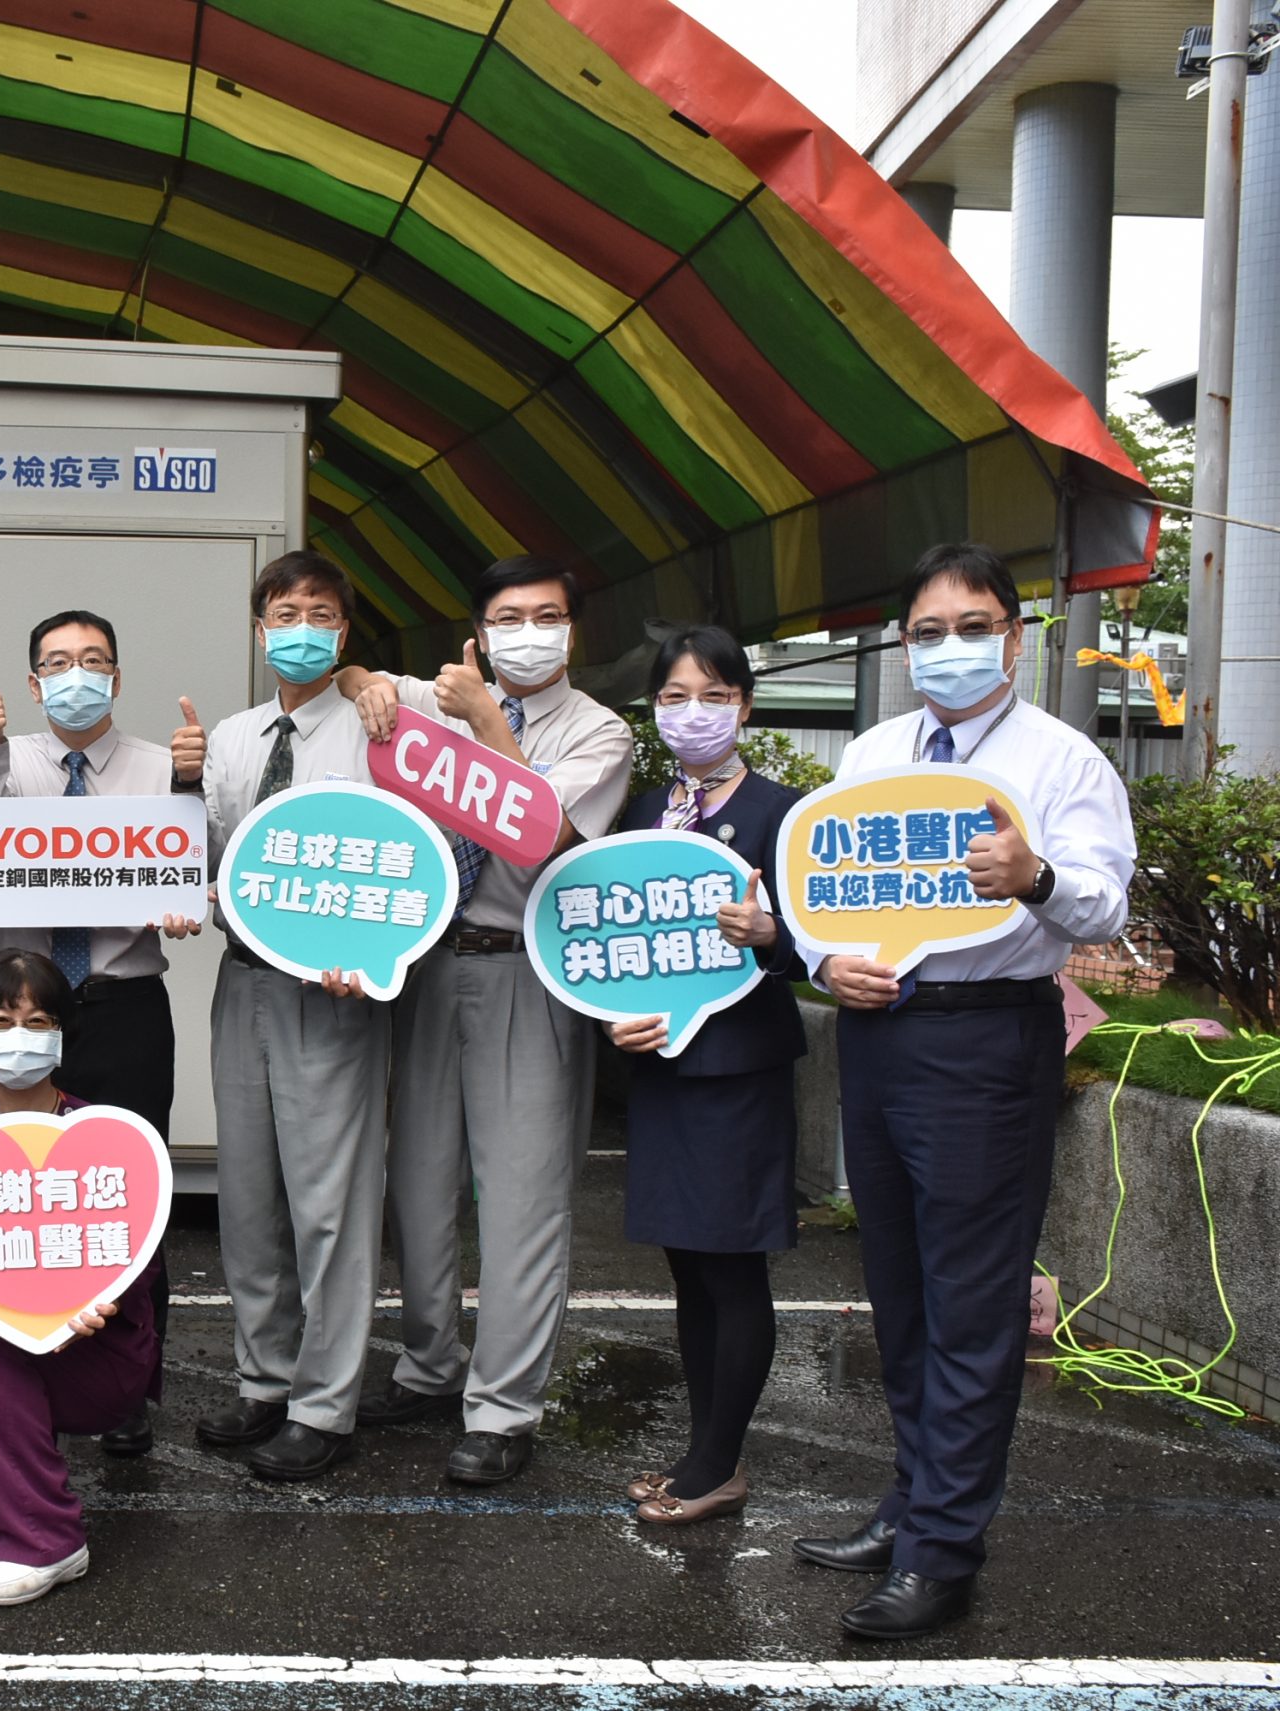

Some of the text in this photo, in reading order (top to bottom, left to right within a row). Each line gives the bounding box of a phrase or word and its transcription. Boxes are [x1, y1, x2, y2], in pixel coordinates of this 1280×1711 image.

[138, 448, 211, 490] SYSCO
[394, 729, 533, 841] CARE
[260, 828, 416, 879] 追求至善
[236, 871, 429, 927] 不止於至善
[557, 872, 734, 931] 齊心防疫
[807, 870, 1007, 908] 與您齊心抗
[563, 928, 742, 982] 共同相挺
